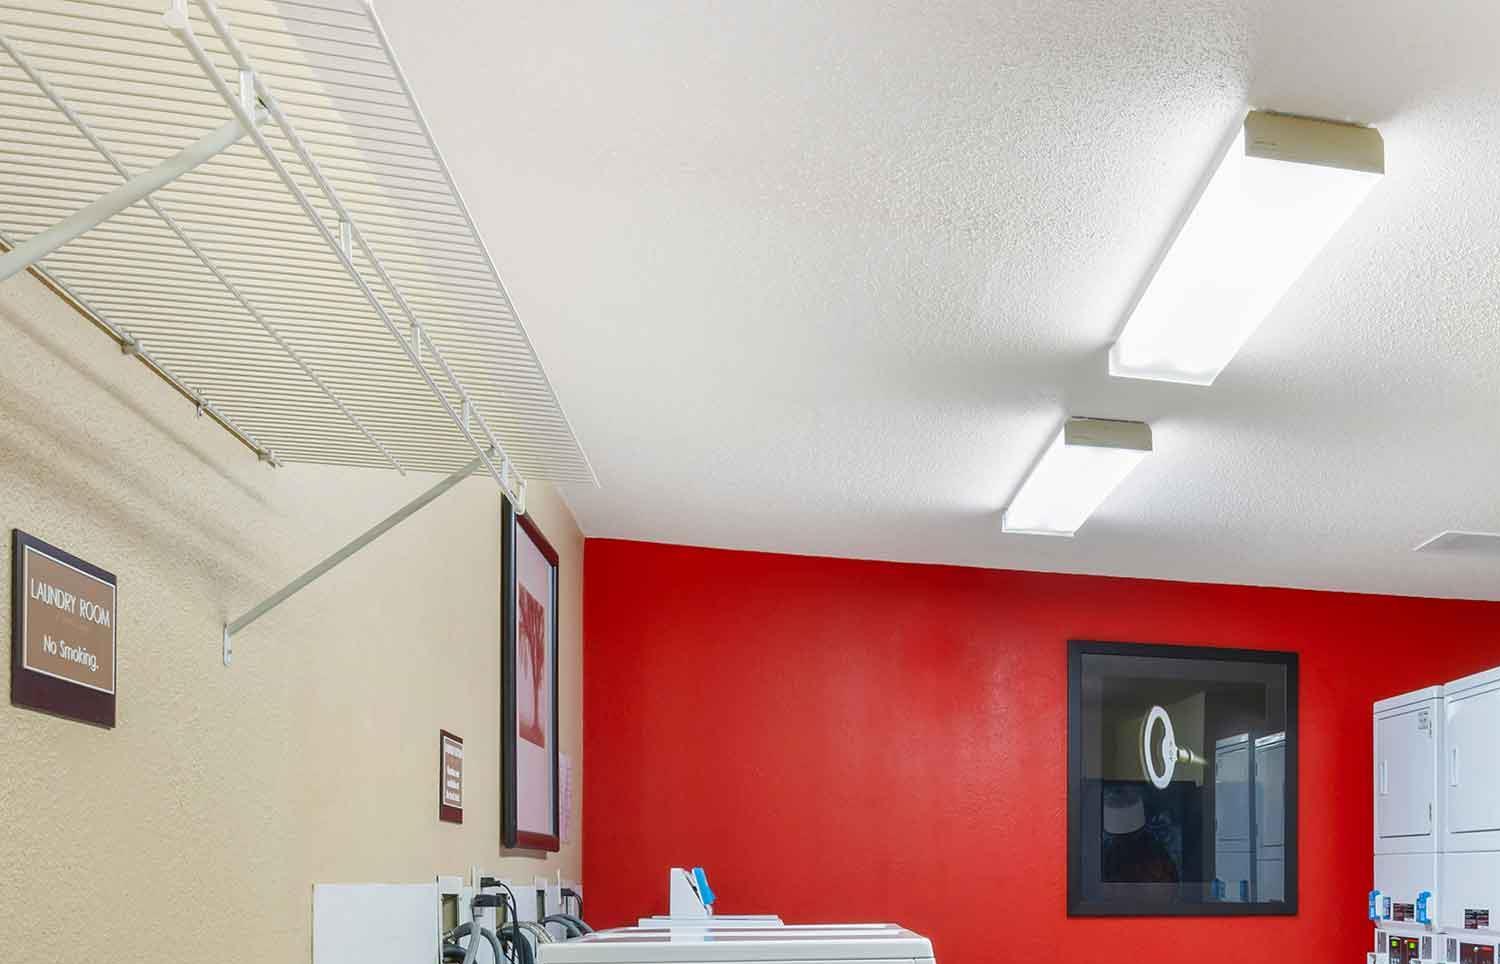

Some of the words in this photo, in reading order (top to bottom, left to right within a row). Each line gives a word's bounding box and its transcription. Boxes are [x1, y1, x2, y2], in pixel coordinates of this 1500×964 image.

[31, 578, 77, 614] LAUNDRY
[79, 598, 111, 628] ROOM
[43, 634, 57, 656] No
